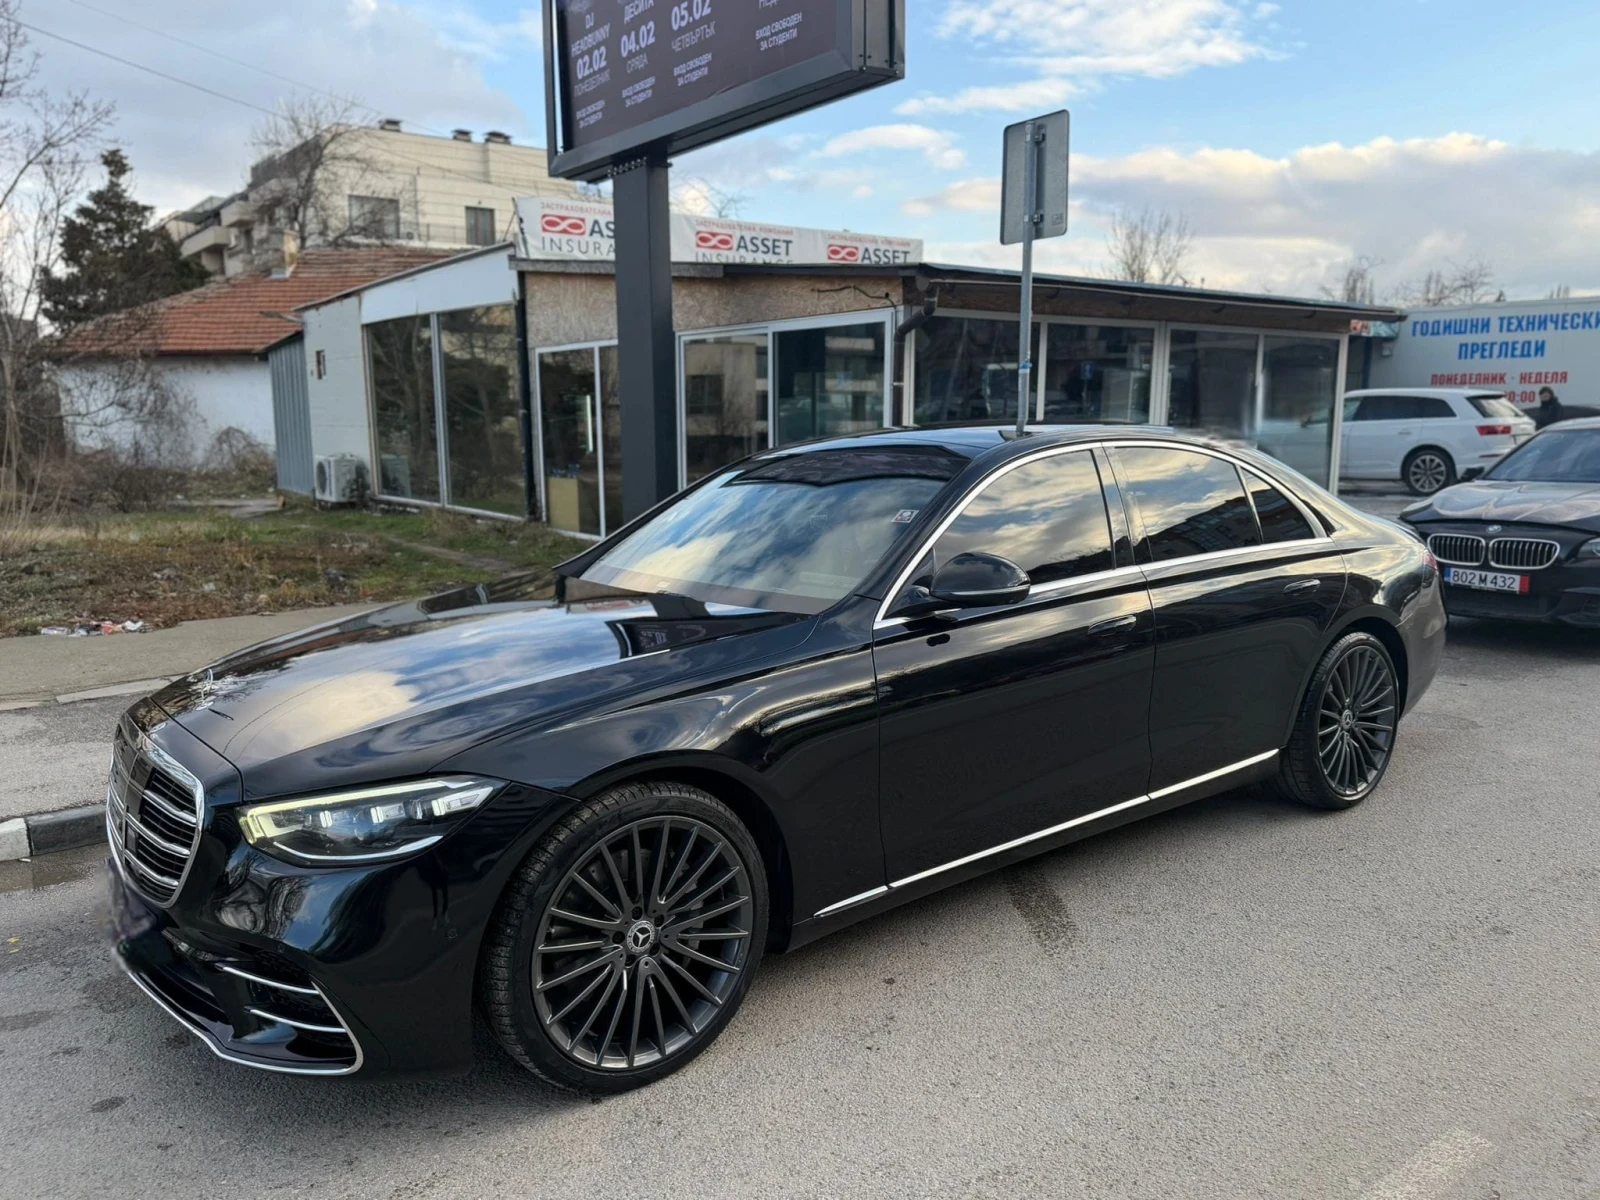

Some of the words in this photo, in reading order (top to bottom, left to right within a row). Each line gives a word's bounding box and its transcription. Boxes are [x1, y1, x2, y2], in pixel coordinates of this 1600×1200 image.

[585, 12, 594, 29] DJ
[671, 0, 712, 31] 05.02
[755, 25, 771, 40] ВХОД
[771, 12, 803, 33] СВОБОДЕН
[621, 20, 656, 58] 04.02
[672, 21, 716, 53] ЧЕТВЪРТЪК
[760, 41, 768, 51] ЗА
[768, 28, 798, 48] СТУДЕНТИ
[577, 46, 607, 80] 02.02
[736, 235, 793, 256] ASSET
[861, 247, 911, 264] ASSET
[695, 252, 793, 264] INSURA
[1411, 317, 1491, 337] ГОДИШНИ
[1458, 340, 1546, 360] ПРЕГЛЕДИ
[1430, 372, 1506, 386] ПОНЕДЕЛНИК
[1519, 371, 1568, 385] НЕДЕЛЯ
[1506, 390, 1535, 403] 0:00
[1452, 570, 1476, 585] 802
[1478, 573, 1488, 586] M
[1490, 574, 1516, 589] 432
